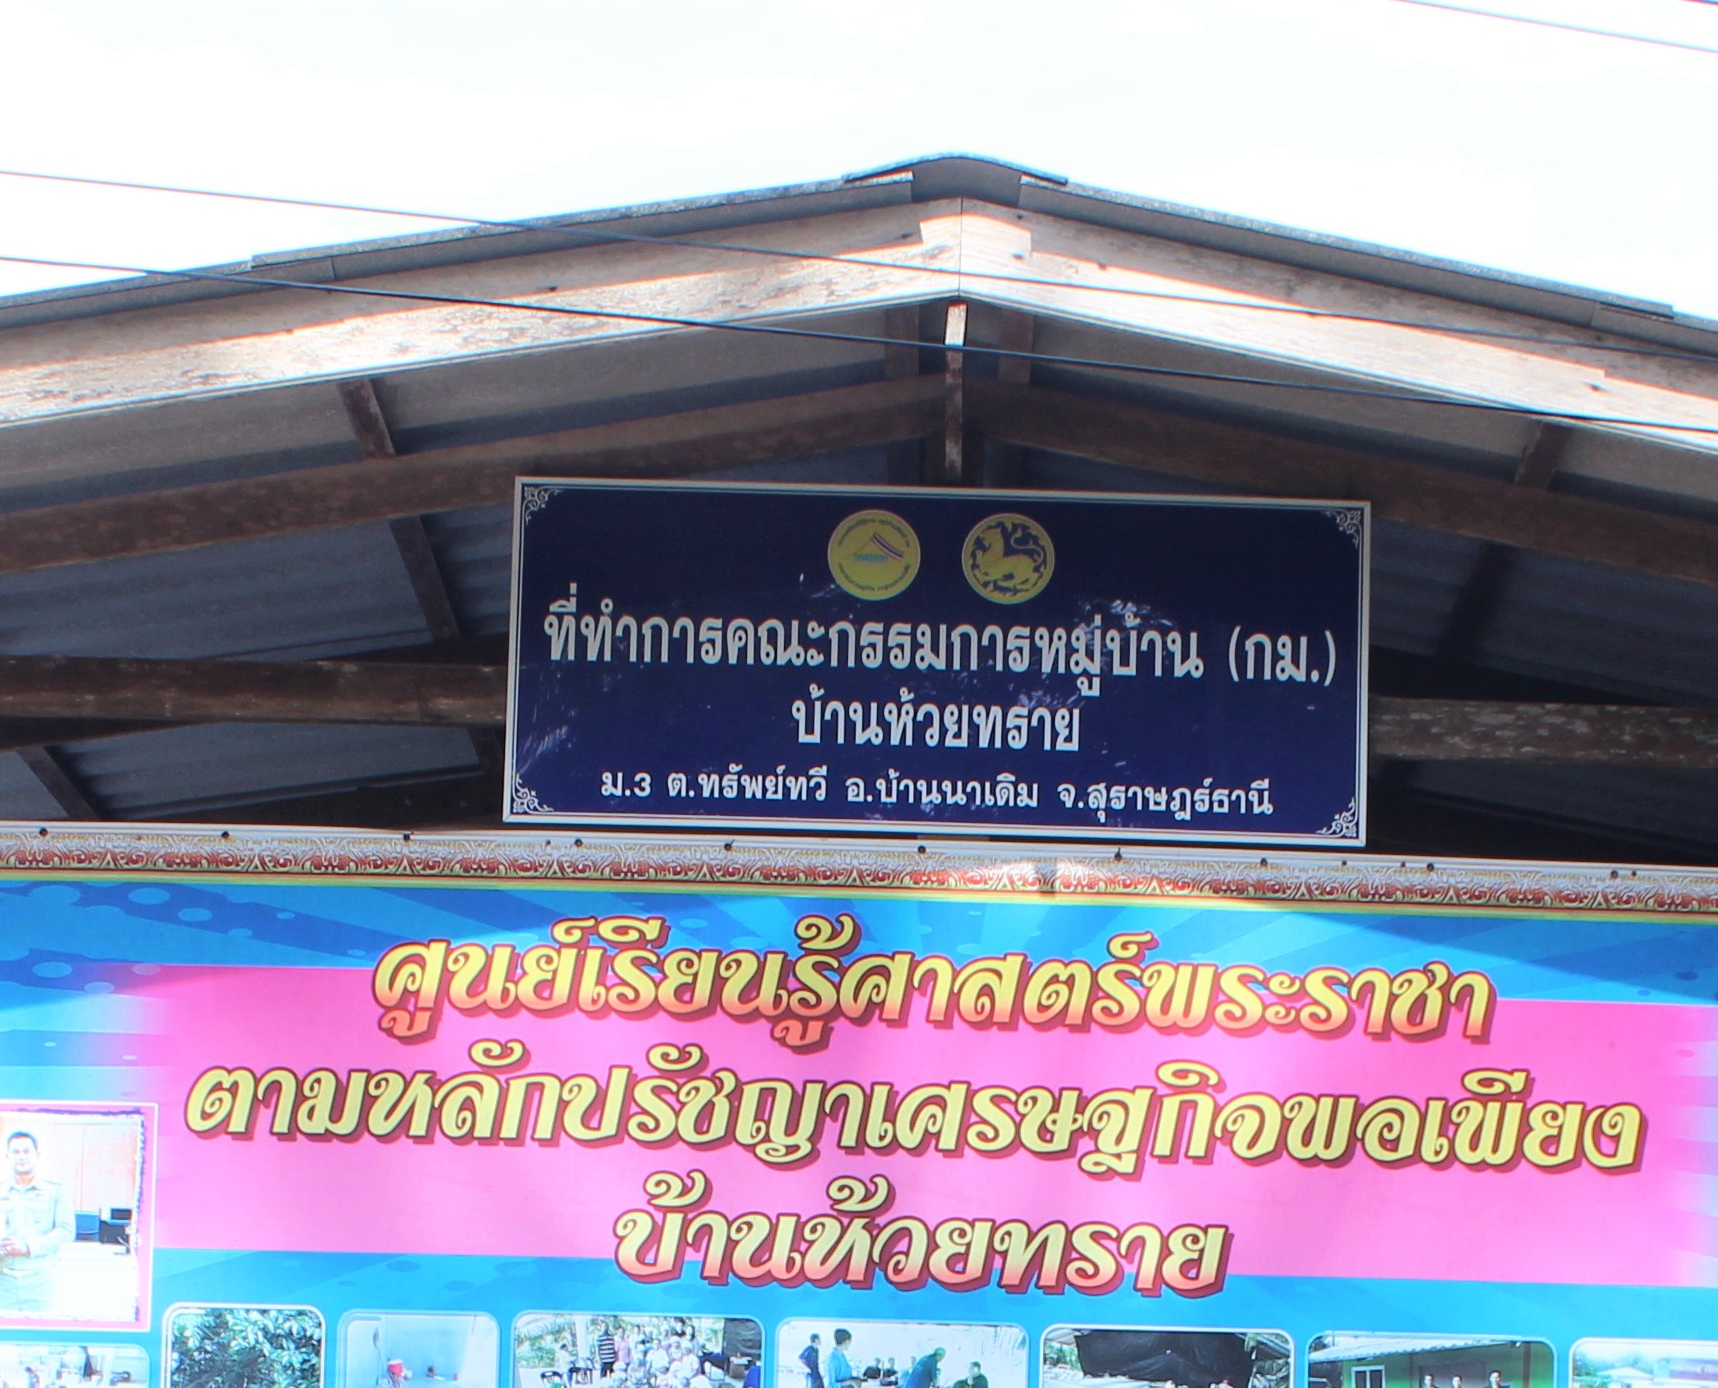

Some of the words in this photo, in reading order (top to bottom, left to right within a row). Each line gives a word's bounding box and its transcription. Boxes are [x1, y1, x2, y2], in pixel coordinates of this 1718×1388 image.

[543, 582, 1203, 697] ที่ทำการคณะกรรมการหมู่บ้าน
[1227, 626, 1338, 686] (กม.)
[791, 687, 1081, 752] บ้านห้วยทราย
[600, 770, 652, 800] ม.3
[667, 764, 828, 804] ต.ทรัพย์ทวี
[845, 768, 1040, 810] อ.บ้านนาเดิม
[1057, 777, 1274, 824] จ.สุราษฎร์ธานี
[372, 911, 1497, 1051] ศูนย์เรียนรู้ศาสตร์พระราชา
[184, 1036, 1647, 1180] ตามหลักปรัชญาเศรษฐกิจพอเพียง
[613, 1170, 1234, 1299] บ้านห้วยทราย
